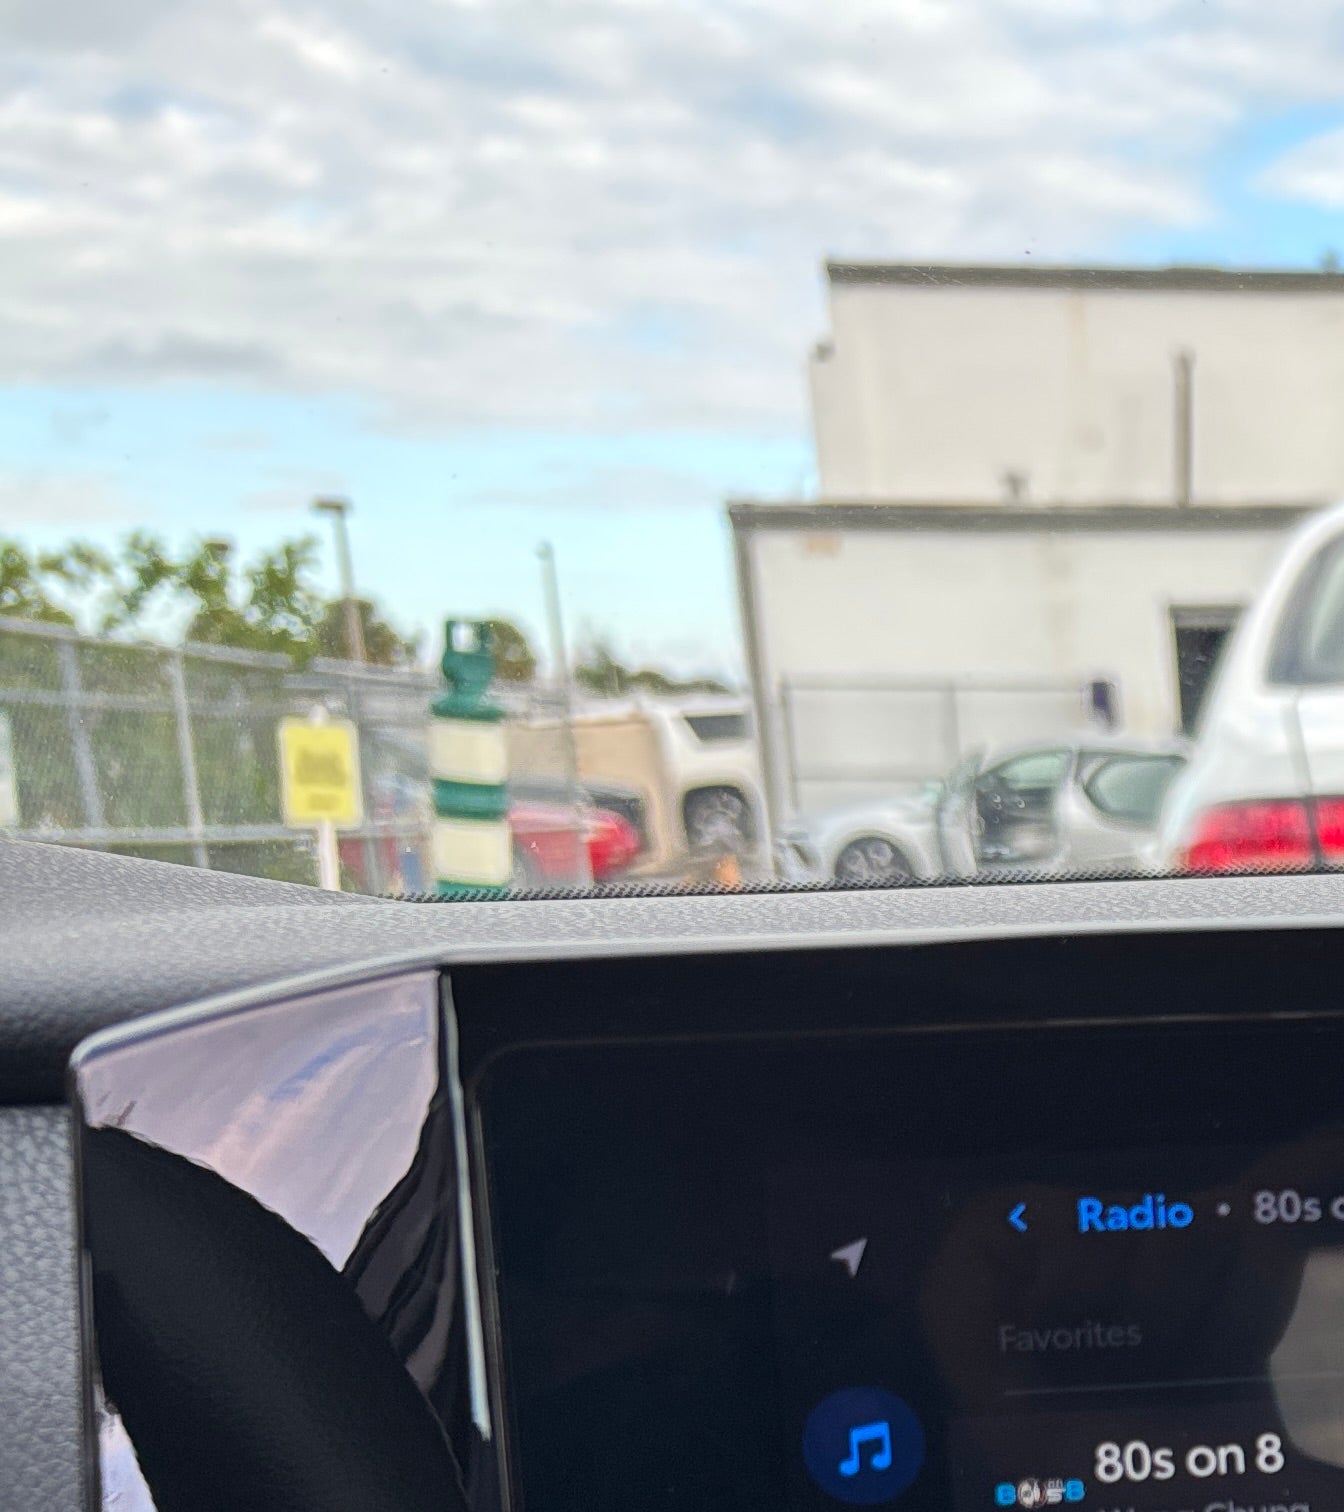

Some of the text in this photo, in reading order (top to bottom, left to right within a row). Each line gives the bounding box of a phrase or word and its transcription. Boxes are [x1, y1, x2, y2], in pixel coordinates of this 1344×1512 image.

[1077, 1193, 1194, 1233] Radio
[1253, 1189, 1322, 1225] 80s
[1001, 1322, 1142, 1352] Favorites
[1095, 1433, 1285, 1483] 80s on 8
